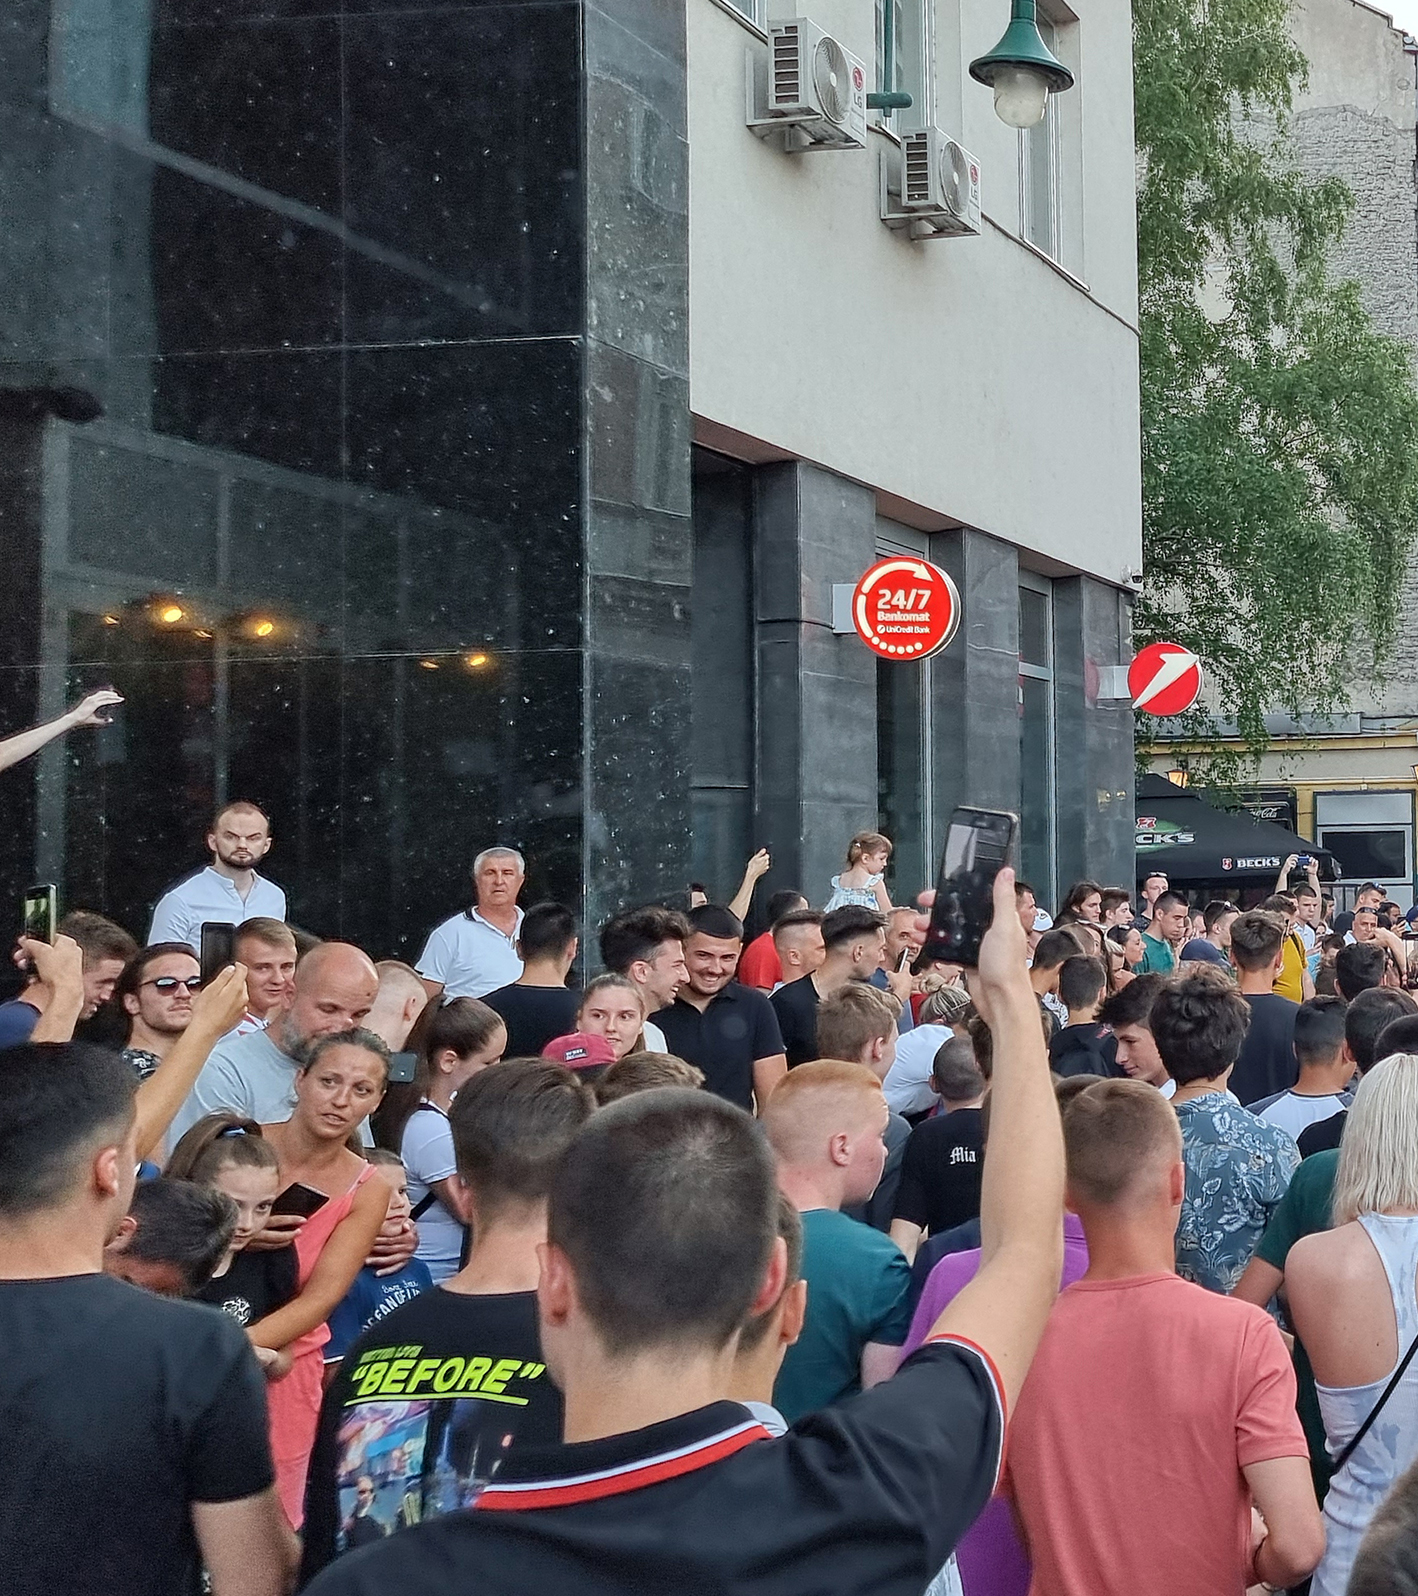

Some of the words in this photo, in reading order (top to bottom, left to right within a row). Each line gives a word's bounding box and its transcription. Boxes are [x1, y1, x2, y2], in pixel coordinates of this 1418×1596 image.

[877, 588, 931, 610] 24/7
[876, 610, 931, 622] Bankomat
[914, 626, 931, 634] Bank
[1236, 857, 1281, 869] BECK'S
